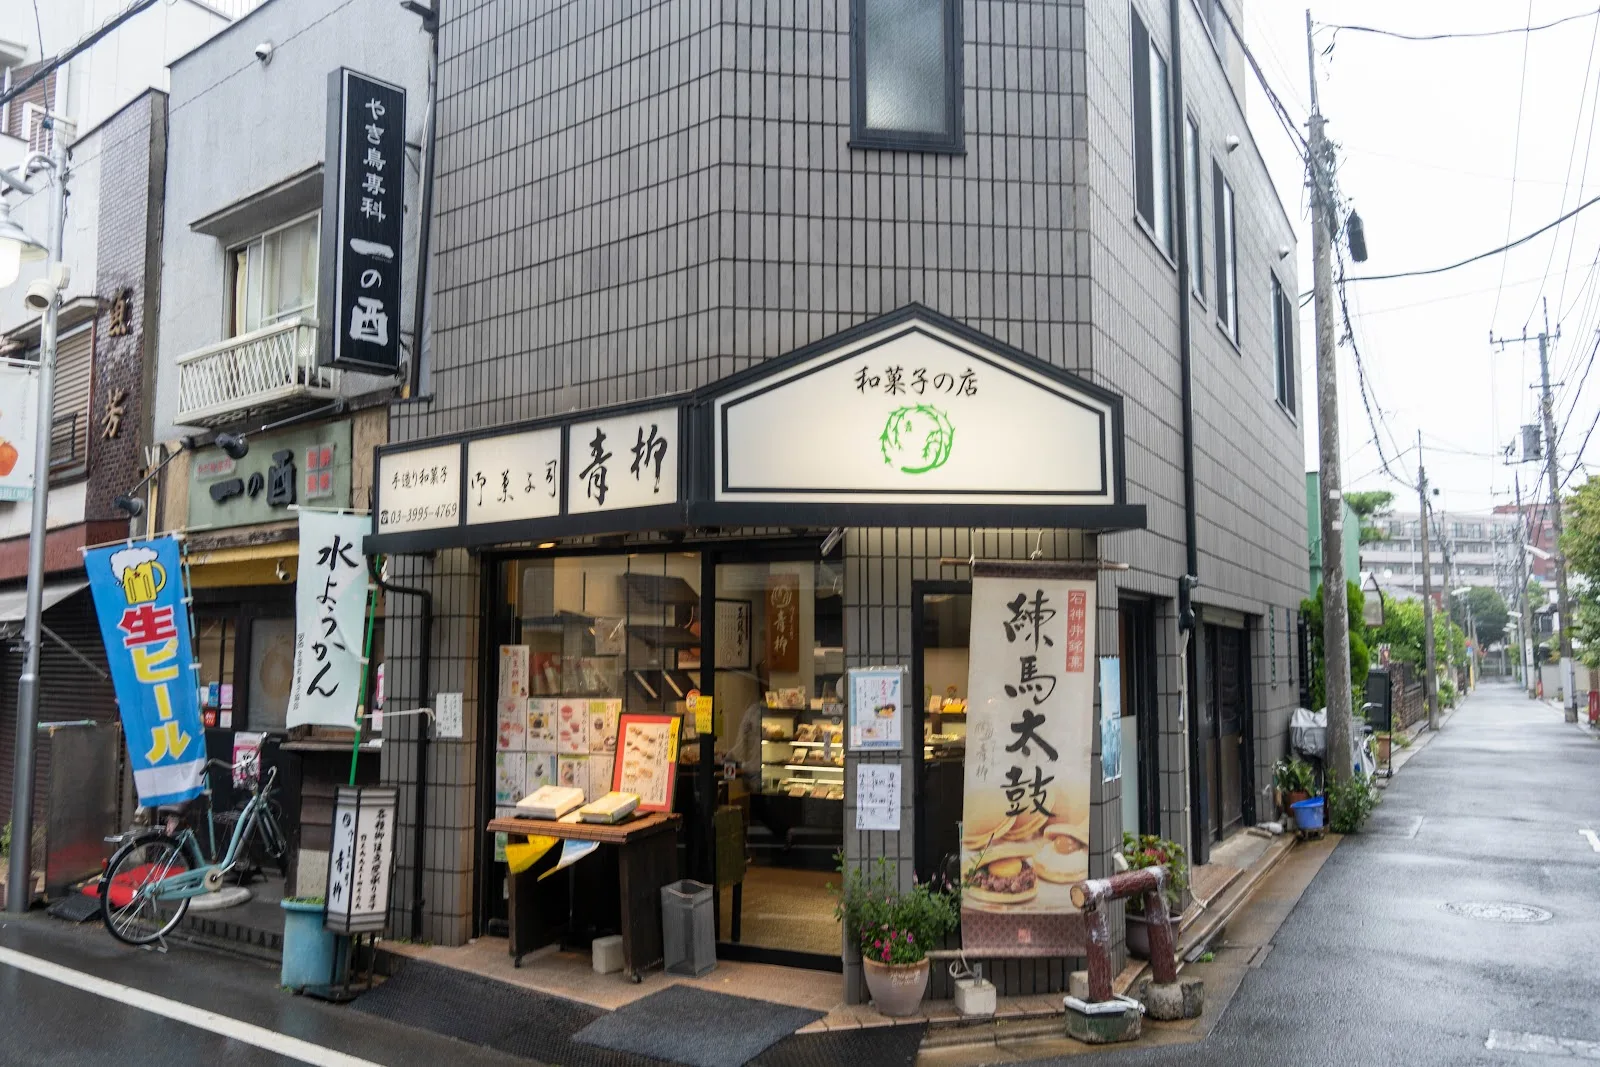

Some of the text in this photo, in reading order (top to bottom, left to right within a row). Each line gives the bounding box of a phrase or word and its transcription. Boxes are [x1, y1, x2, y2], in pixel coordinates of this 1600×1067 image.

[360, 97, 387, 223] やき鳥専科
[348, 237, 395, 347] 一の酉
[854, 365, 979, 397] 和菓子の店
[209, 449, 297, 507] 一の酉
[391, 465, 449, 490] 手造り和菓子
[579, 423, 669, 507] 青柳
[390, 502, 458, 525] 03-3995-4769
[306, 534, 360, 698] 水ようかん
[1067, 592, 1085, 670] 石神井銘菓
[117, 602, 192, 765] 生ビール
[1001, 588, 1059, 818] 練馬太鼓
